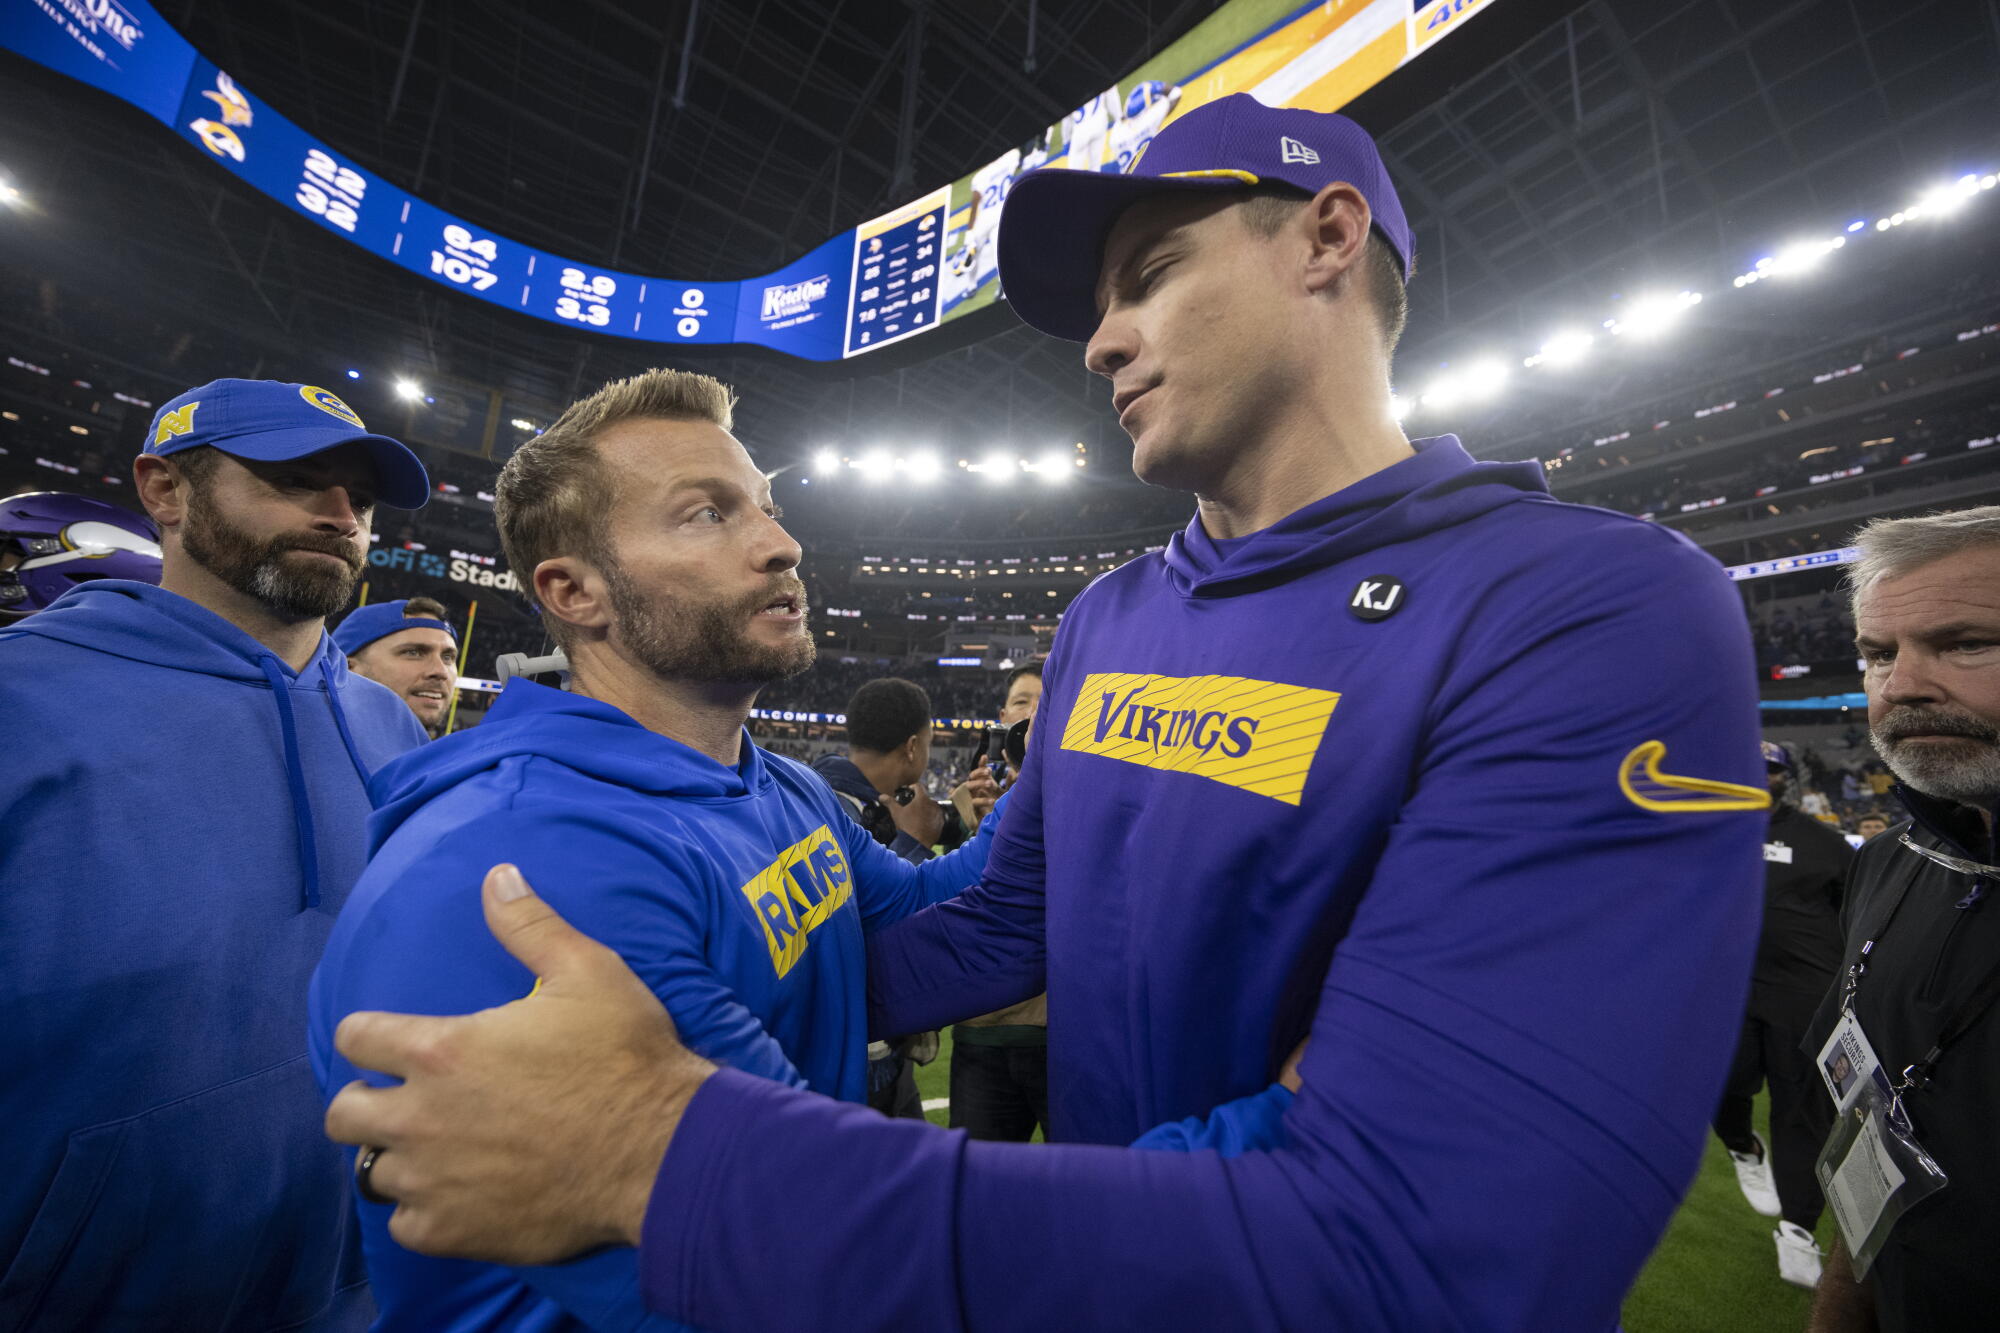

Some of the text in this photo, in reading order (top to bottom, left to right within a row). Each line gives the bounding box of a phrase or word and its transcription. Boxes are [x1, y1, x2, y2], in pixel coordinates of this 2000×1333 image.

[304, 149, 367, 200] 22
[295, 183, 359, 233] 32
[431, 250, 498, 291] 107
[555, 297, 611, 327] 3.3
[681, 288, 705, 309] 0
[677, 316, 700, 338] 0
[368, 547, 415, 572] oFi
[450, 559, 525, 593] Stadi
[1351, 580, 1401, 611] KJ
[749, 708, 847, 724] ELCOME TO
[757, 840, 848, 953] RAMS
[1840, 1032, 1862, 1072] SECURITY
[1846, 1027, 1866, 1064] VIKINGS
